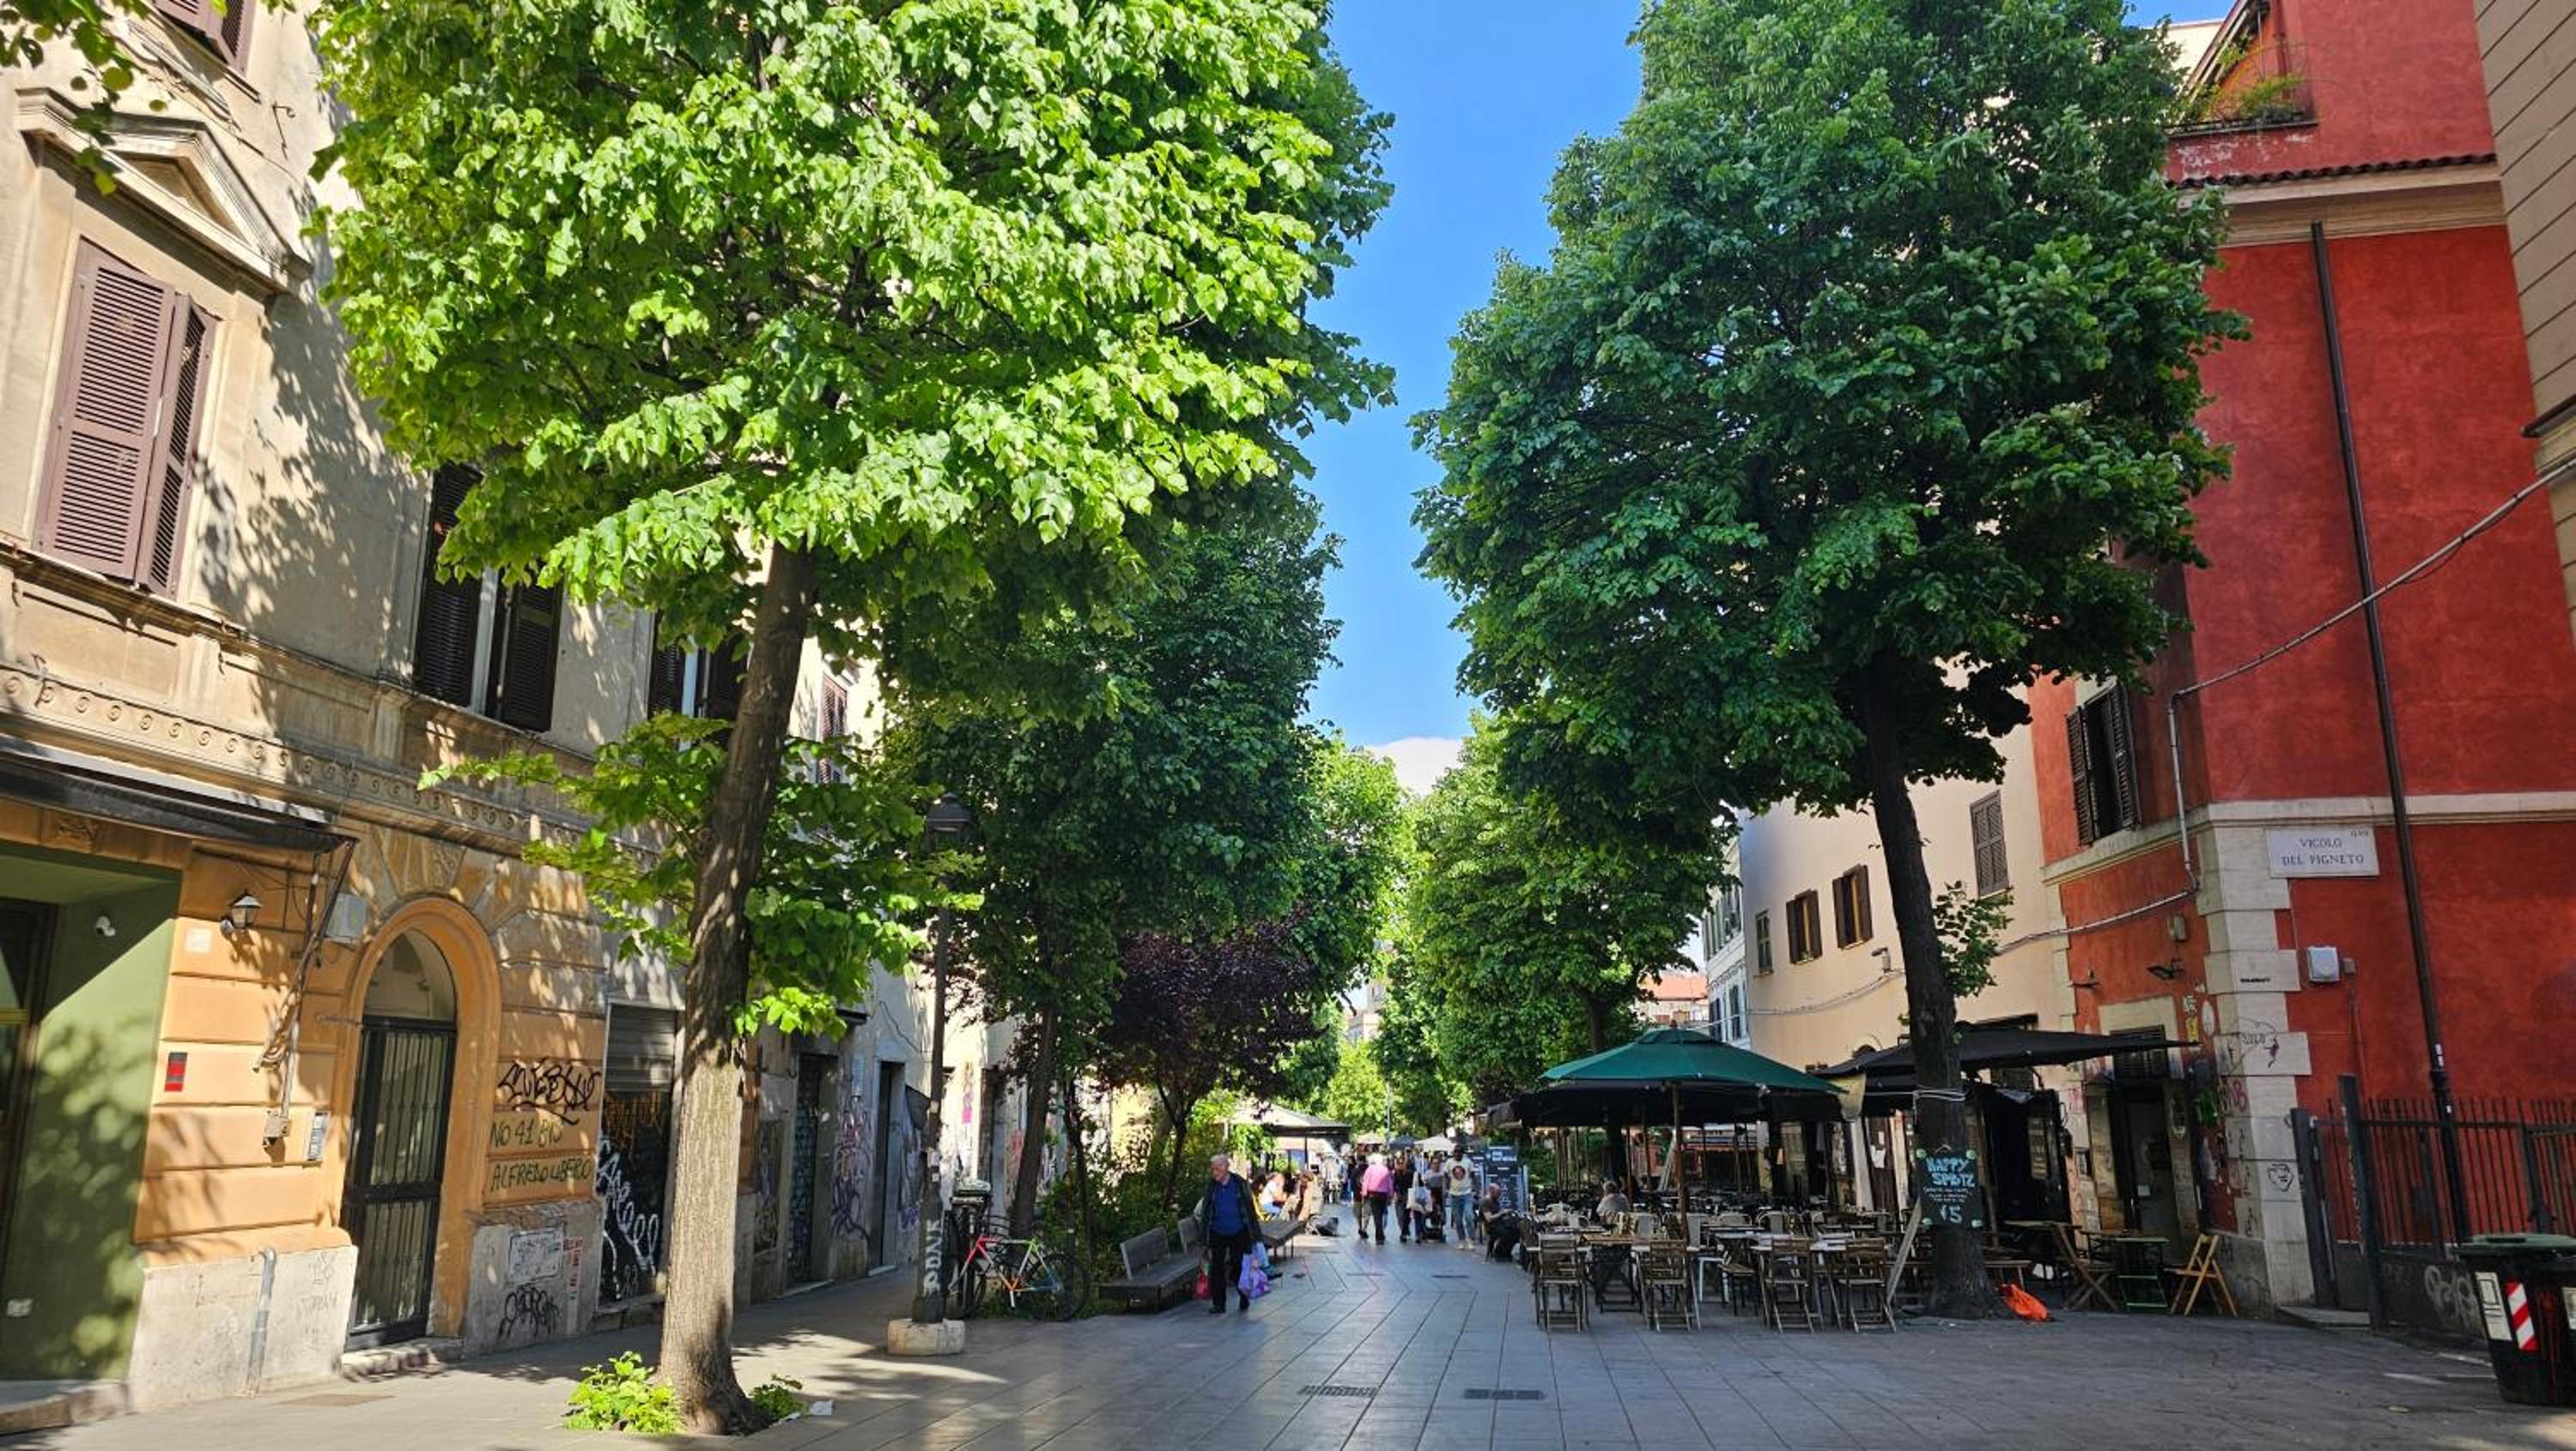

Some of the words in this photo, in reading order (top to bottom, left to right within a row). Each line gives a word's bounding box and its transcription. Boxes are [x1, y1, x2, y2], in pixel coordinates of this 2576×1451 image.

[2299, 837, 2342, 847] VICOLO
[2281, 855, 2305, 865] DEL
[2309, 853, 2364, 865] PIGNETO
[515, 1119, 535, 1145] 41
[1926, 1157, 1970, 1173] HAPPY
